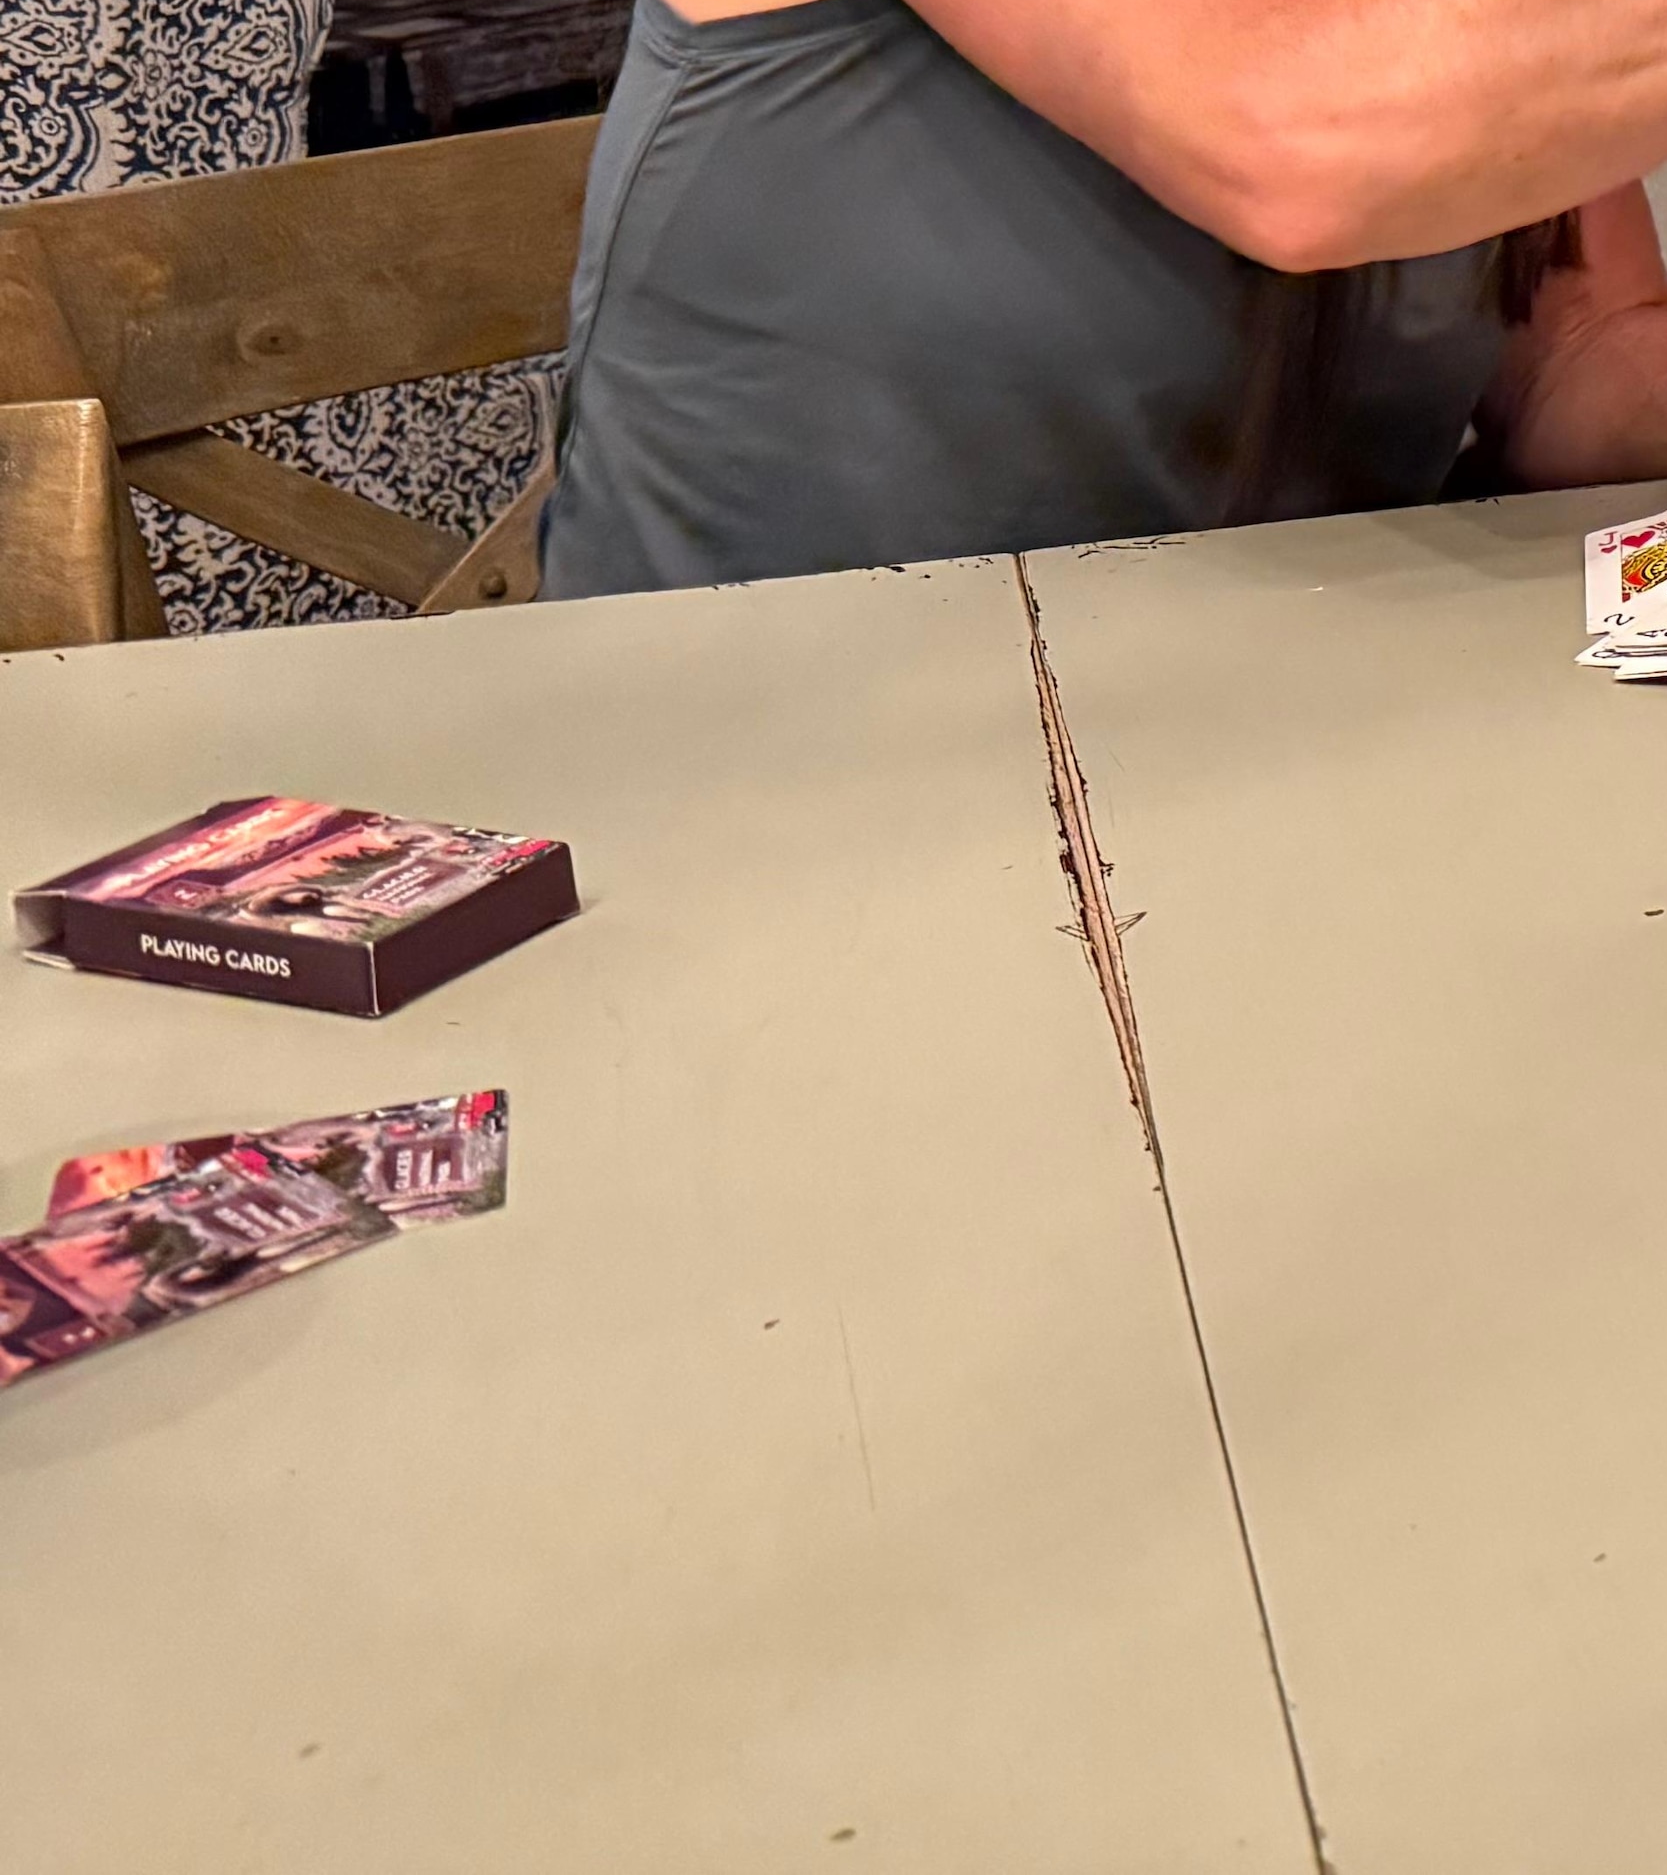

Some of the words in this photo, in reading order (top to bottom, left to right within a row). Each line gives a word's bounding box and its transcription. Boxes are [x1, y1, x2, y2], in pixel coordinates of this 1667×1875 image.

[1598, 531, 1619, 547] J
[1603, 613, 1635, 626] 2
[141, 934, 220, 966] PLAYING
[225, 948, 292, 978] CARDS
